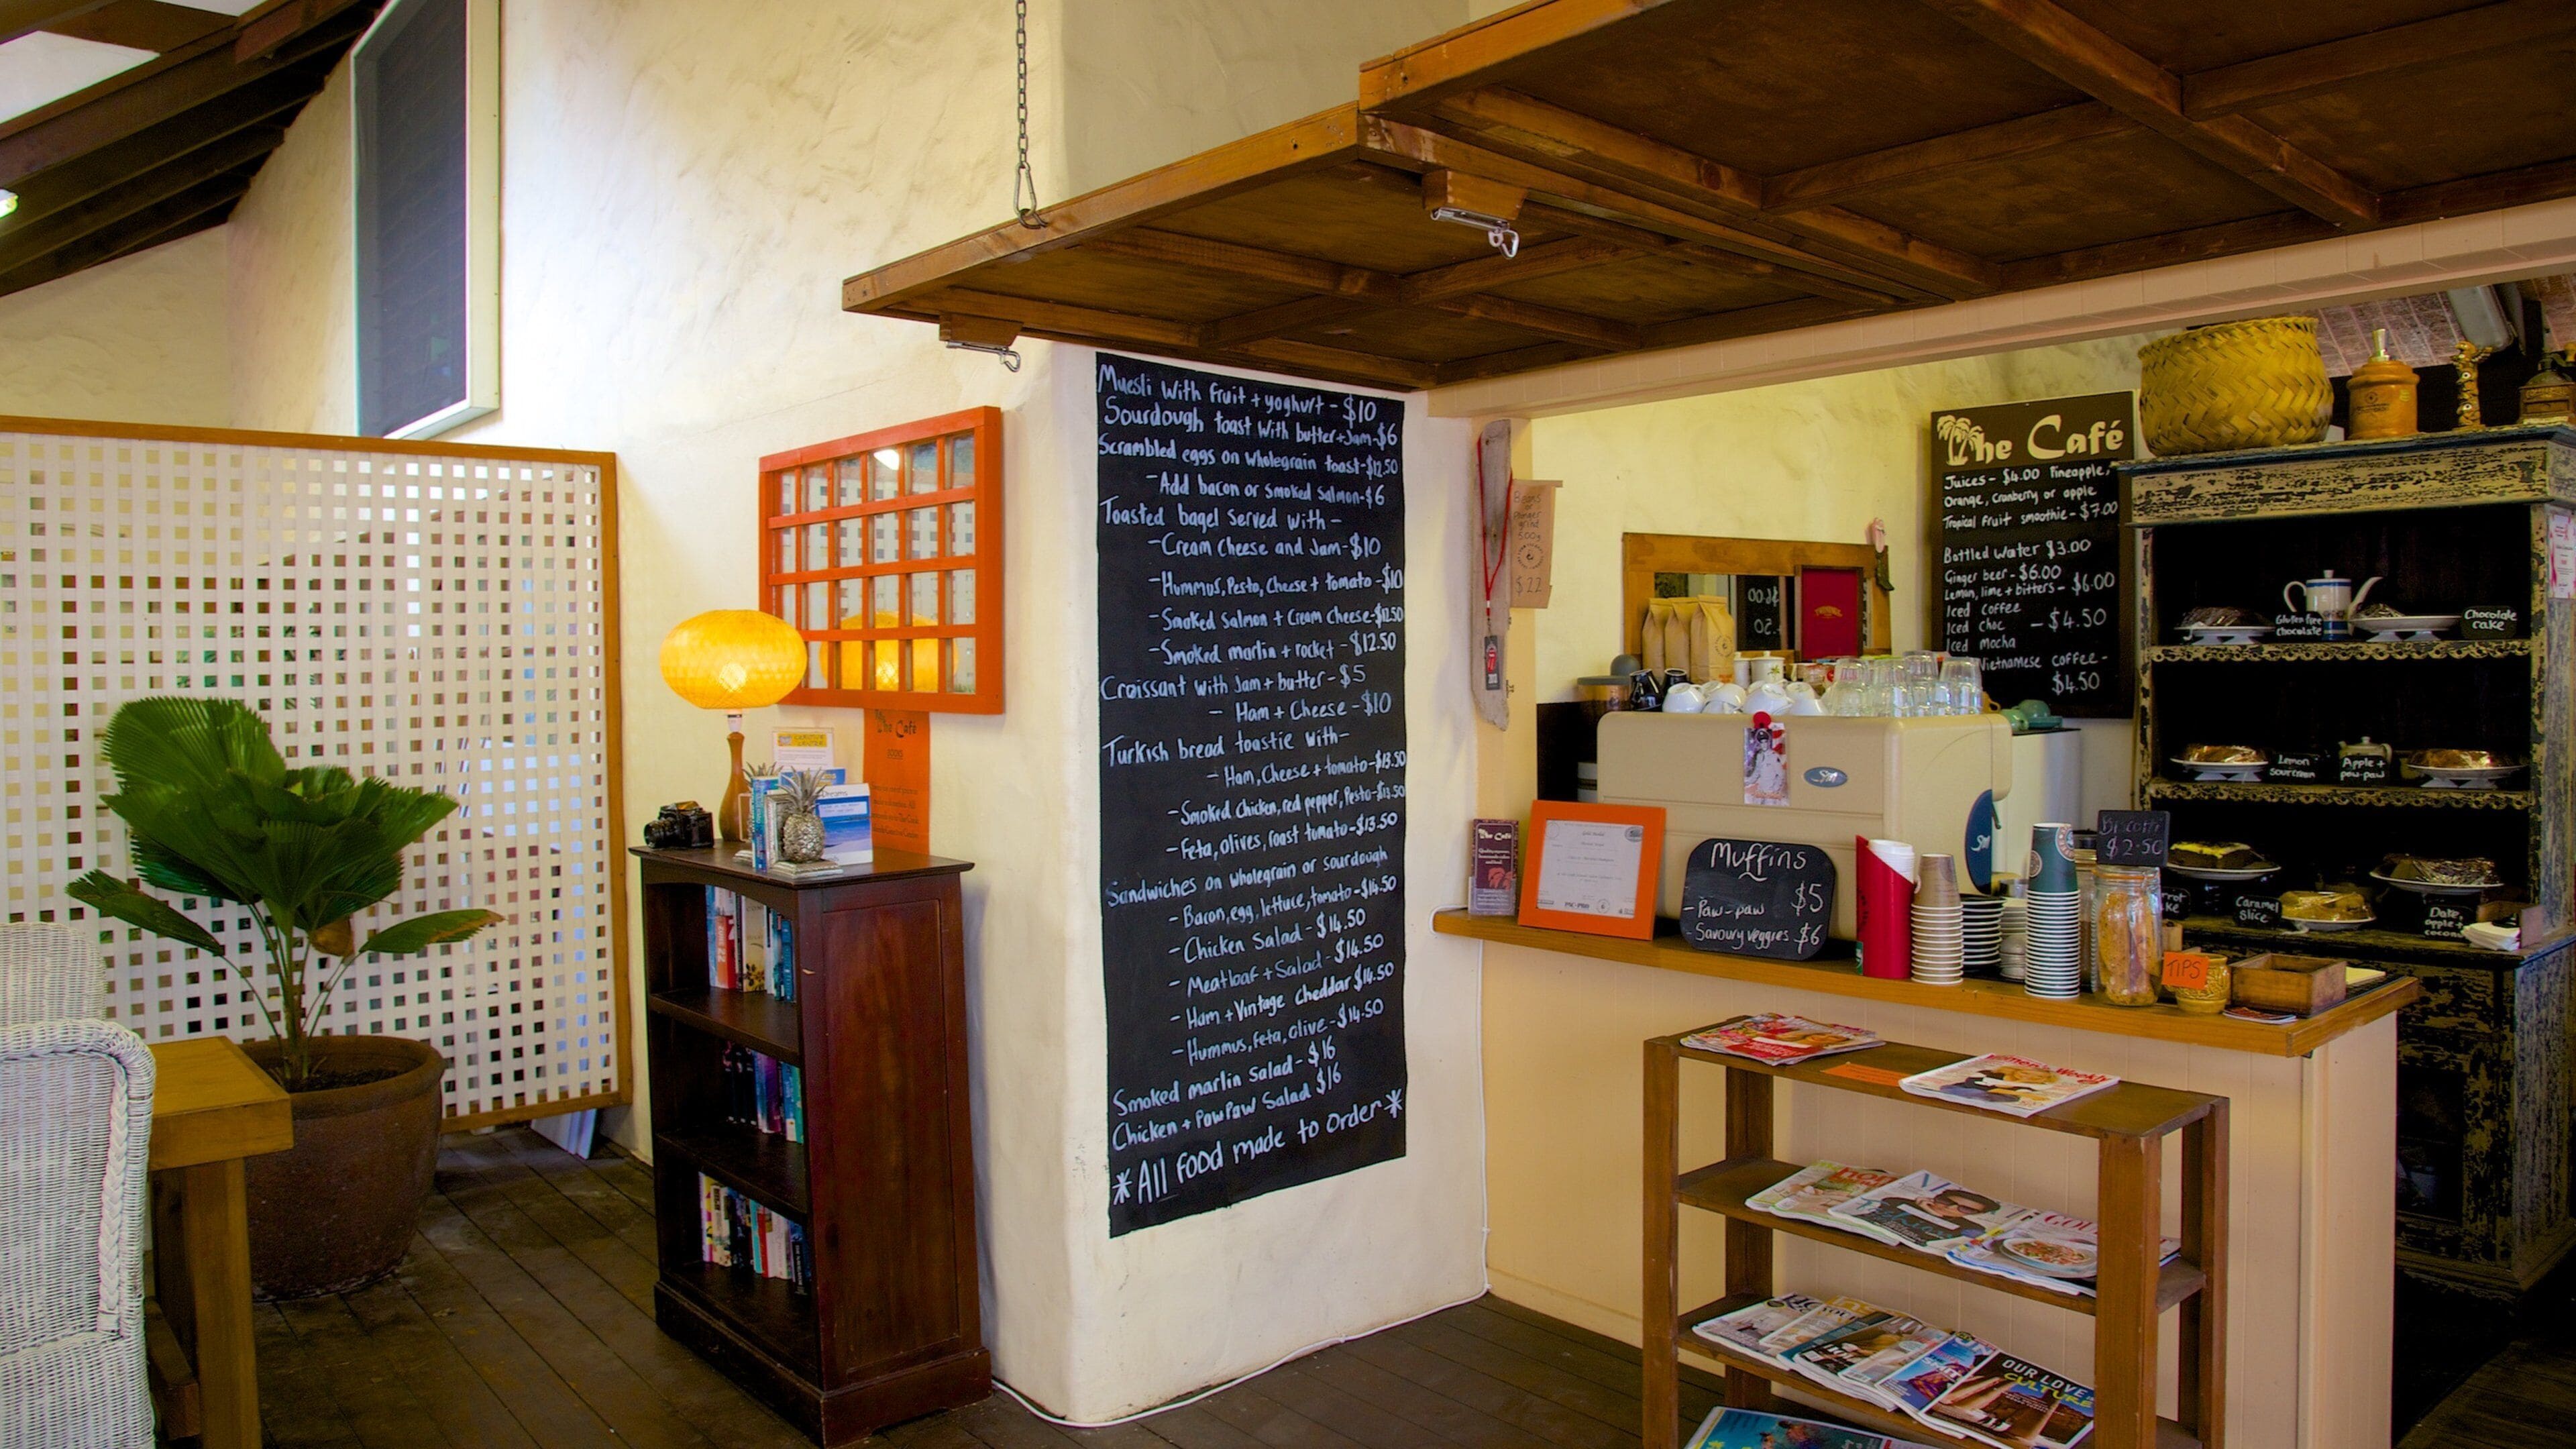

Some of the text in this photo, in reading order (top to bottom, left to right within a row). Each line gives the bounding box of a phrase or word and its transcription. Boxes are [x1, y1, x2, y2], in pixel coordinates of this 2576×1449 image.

[1097, 365, 1152, 397] Muesli
[1265, 396, 1324, 417] yoghurt
[1343, 395, 1377, 429] $10
[1104, 396, 1204, 433] Sourdough
[1214, 414, 1252, 436] toast
[1099, 433, 1177, 460] Scrambled
[1181, 451, 1215, 466] eggs
[1222, 452, 1240, 465] on
[2027, 414, 2125, 460] Café
[1160, 472, 1189, 495] Add
[1198, 474, 1240, 496] bacon
[1944, 463, 2110, 490] Juices $4.00 Pineapple,
[1099, 496, 1165, 526] Toasted
[1178, 504, 1219, 533] bagel
[1944, 495, 1989, 508] Orange,
[2021, 506, 2068, 525] smoothie
[2079, 500, 2118, 521] $7.00
[1275, 537, 1304, 555] and
[1943, 545, 1989, 564] Bottled
[2046, 539, 2091, 559] $3.00
[1325, 573, 1373, 588] tomato
[1944, 572, 2114, 601] Lemon, lime bitters $6.00
[1945, 563, 2061, 584] Ginger beer $6.00
[1161, 608, 1268, 631] Smoked Salmon
[1947, 602, 1970, 617] Iced
[1947, 607, 2107, 635] Iced Choc $4.50
[2473, 620, 2504, 631] cake
[1161, 632, 1397, 665] Smoked marlin rocket $12.50
[1946, 638, 1969, 652] Iced
[1979, 655, 2042, 671] Vietnamese
[1100, 665, 1366, 700] Croissant Jam butter $5
[2052, 671, 2100, 696] $4.50
[1236, 702, 1270, 722] Ham
[1361, 690, 1392, 716] $10
[896, 720, 916, 737] Café
[1102, 731, 1295, 767] Turkish bread toastie
[2278, 755, 2310, 765] Lemon
[2343, 757, 2373, 770] Apple
[1181, 800, 1232, 826] Smoked
[1283, 794, 1301, 810] red
[1269, 827, 1299, 846] roast
[1711, 843, 1807, 875] Muffins
[1107, 877, 1197, 908] Sandwiches
[1204, 877, 1222, 892] on
[1323, 845, 1388, 872] sourdough
[1311, 883, 1352, 908] tomato
[1790, 881, 1823, 916] $5
[2236, 896, 2279, 913] Caramel
[1184, 907, 1366, 965] Chicken Salad $14.50
[1695, 922, 1823, 954] Savoury veggies $6
[2424, 930, 2464, 938] coconu
[1187, 933, 1384, 998] Meatloaf Salad $14.50
[2167, 959, 2200, 979] TIPS
[1186, 1007, 1221, 1031] Ham
[1352, 962, 1395, 992] $14.50
[1288, 998, 1384, 1040] olive $14.50
[1112, 1035, 1336, 1117] Smoked marlin Salad $16
[1112, 1120, 1178, 1152] Chicken
[1261, 1082, 1312, 1112] Salad
[1316, 1061, 1342, 1095] $16
[1232, 1125, 1285, 1165] made
[1297, 1117, 1320, 1144] to
[2002, 1360, 2088, 1398] OUR LOVE
[2005, 1373, 2092, 1407] CULTURE
